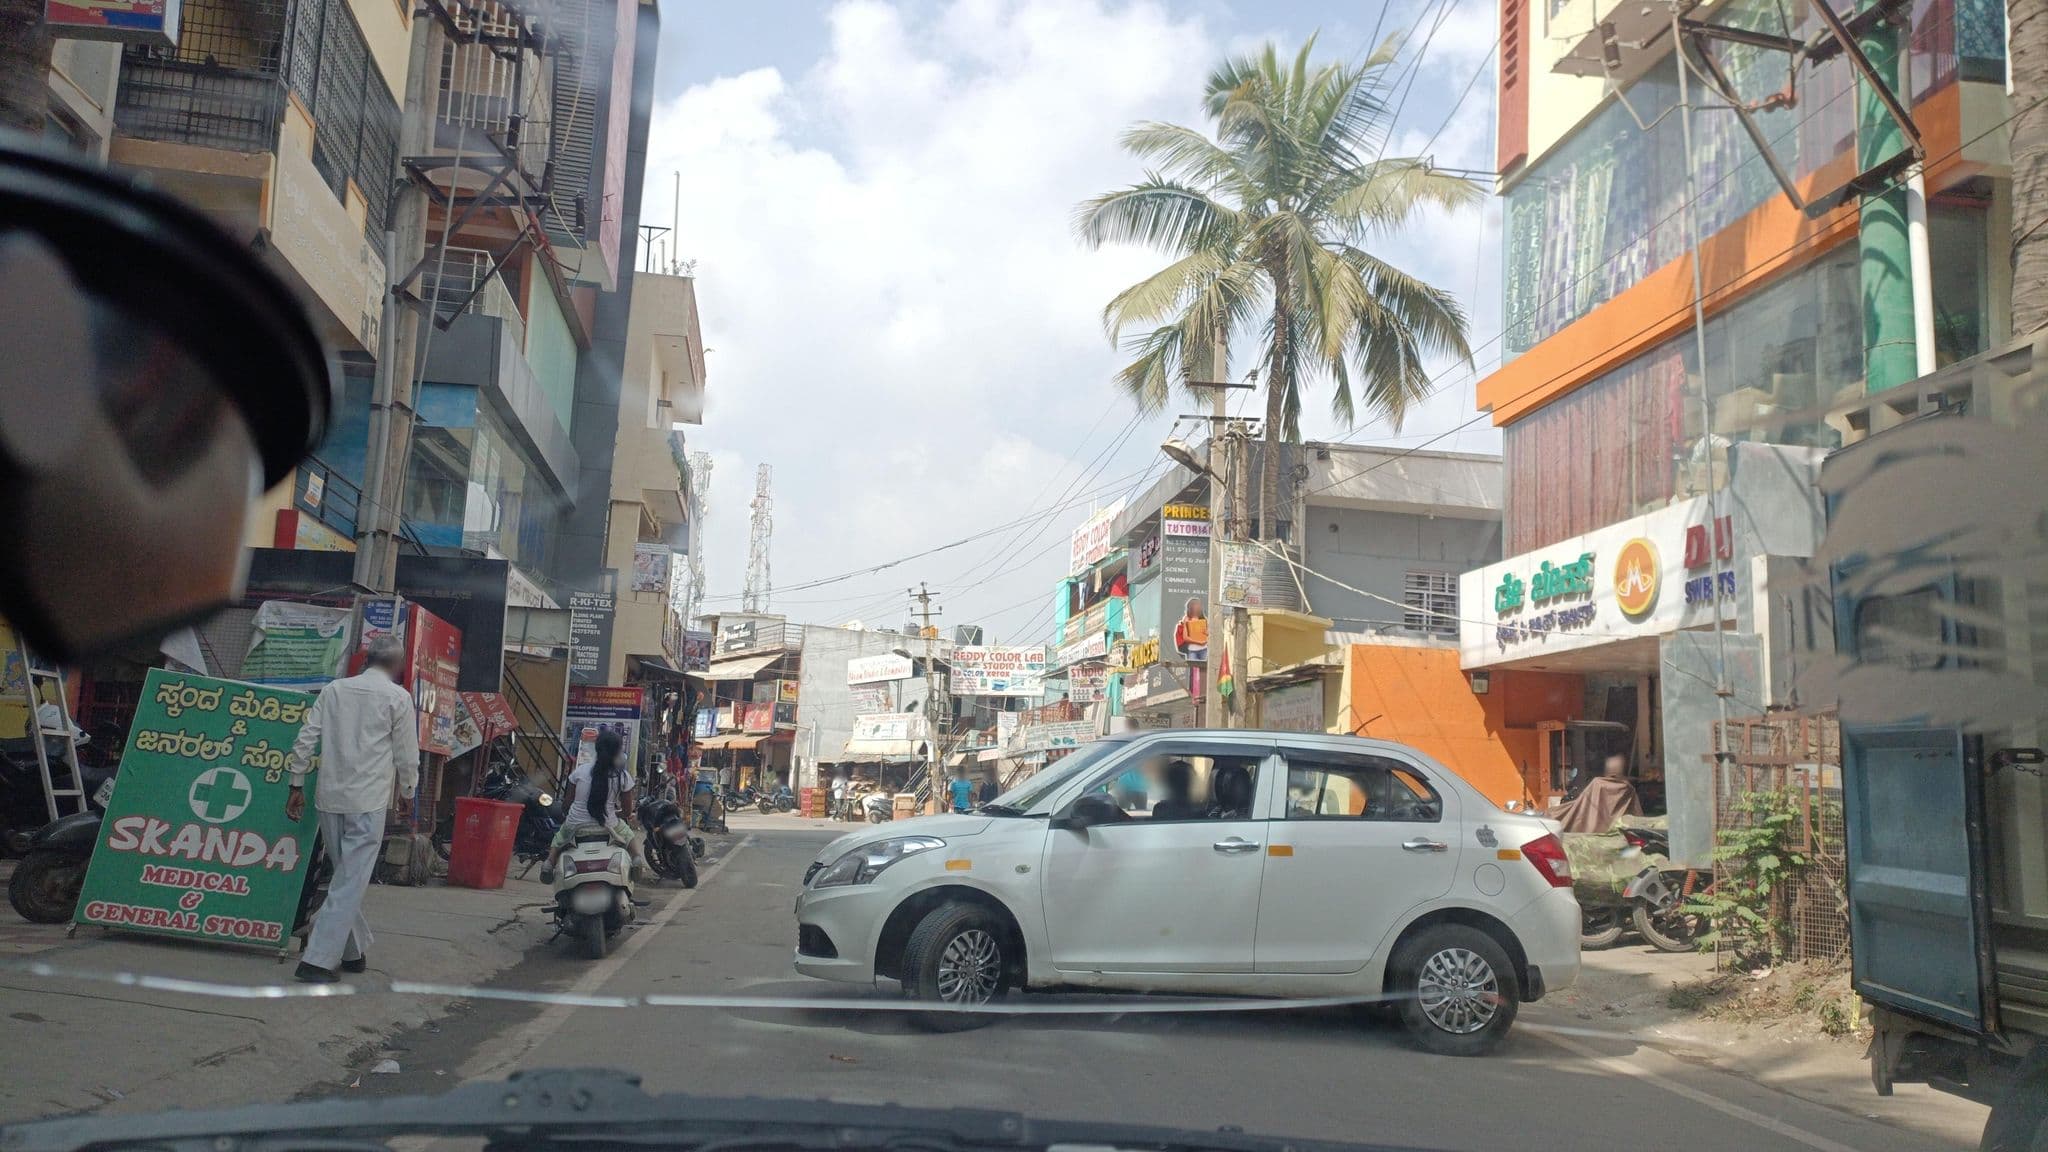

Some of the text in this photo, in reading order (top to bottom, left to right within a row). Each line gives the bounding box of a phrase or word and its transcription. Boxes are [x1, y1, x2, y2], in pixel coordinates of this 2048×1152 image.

[1685, 571, 1736, 604] SWETS
[953, 651, 1044, 663] REDDY COLOR LAB
[983, 662, 1016, 670] STUDIO
[1071, 668, 1104, 678] STUDIO
[156, 680, 224, 717] ಸ್ಕಂದ
[230, 719, 248, 736] &
[136, 729, 235, 760] ಜನರಲ್
[108, 816, 300, 871] SKANDA
[141, 864, 250, 895] MEDICAL
[179, 891, 204, 910] &
[85, 900, 283, 942] GENERAL STORE
